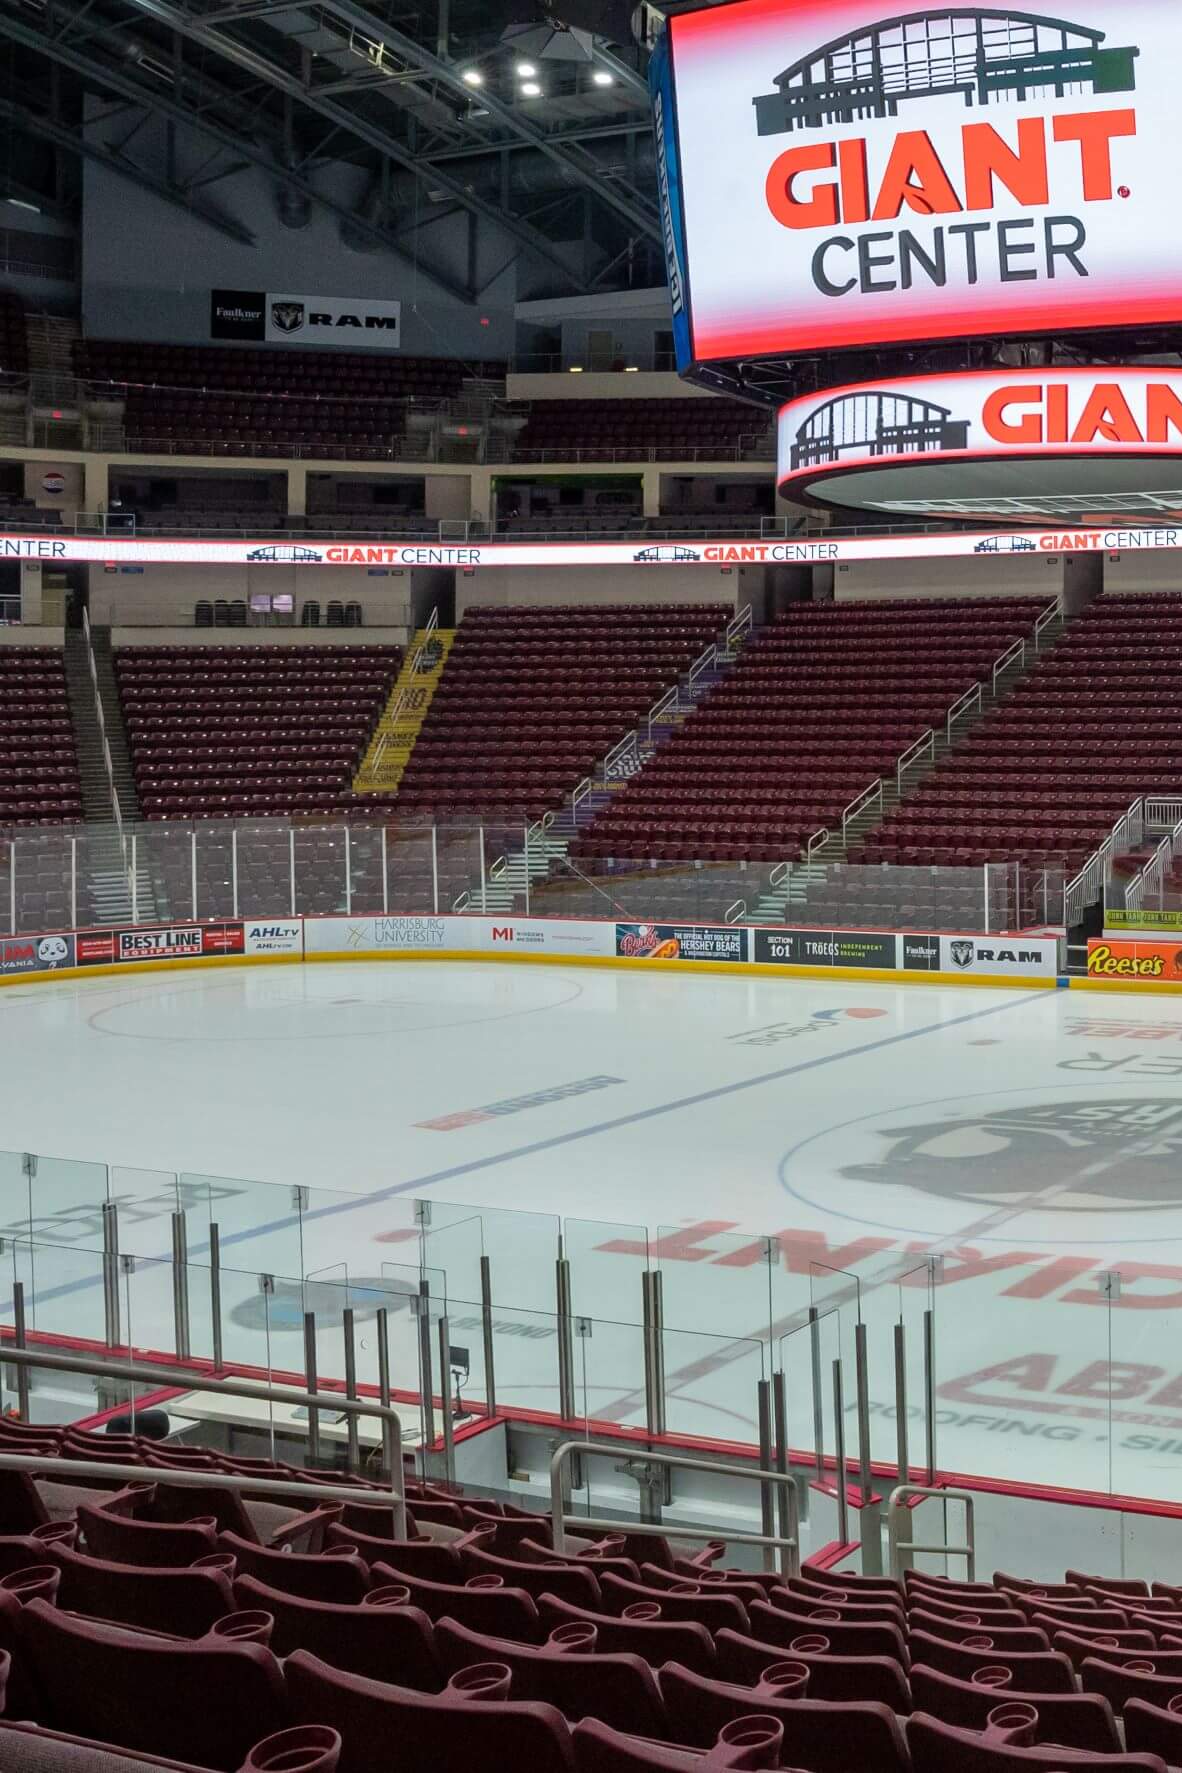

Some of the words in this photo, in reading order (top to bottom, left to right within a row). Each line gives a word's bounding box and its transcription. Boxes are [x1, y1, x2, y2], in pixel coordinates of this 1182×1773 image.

[765, 109, 1137, 230] GIANT
[811, 215, 1089, 297] CENTER
[216, 306, 262, 319] Faulkner
[309, 313, 396, 330] RAM
[1039, 533, 1101, 550] GIANT
[1104, 530, 1177, 547] CENTER
[326, 548, 397, 563] GIANT
[401, 548, 481, 564] CENTER
[703, 547, 769, 561] GIANT
[771, 543, 838, 561] CENTER
[374, 918, 445, 930] HARRISBURG
[122, 933, 162, 950] BEST
[166, 932, 200, 947] LINE
[375, 930, 444, 943] UNIVERSITY
[492, 927, 514, 941] MI
[767, 936, 793, 945] SECTION
[124, 945, 200, 956] EQUIPMENT
[681, 940, 714, 951] HERSHEY
[716, 941, 740, 952] BEARS
[770, 945, 790, 958] 101
[906, 945, 937, 955] Faulkner
[977, 949, 1041, 963] RAM
[1088, 944, 1164, 977] Reese's
[844, 1400, 1081, 1442] ROOFING
